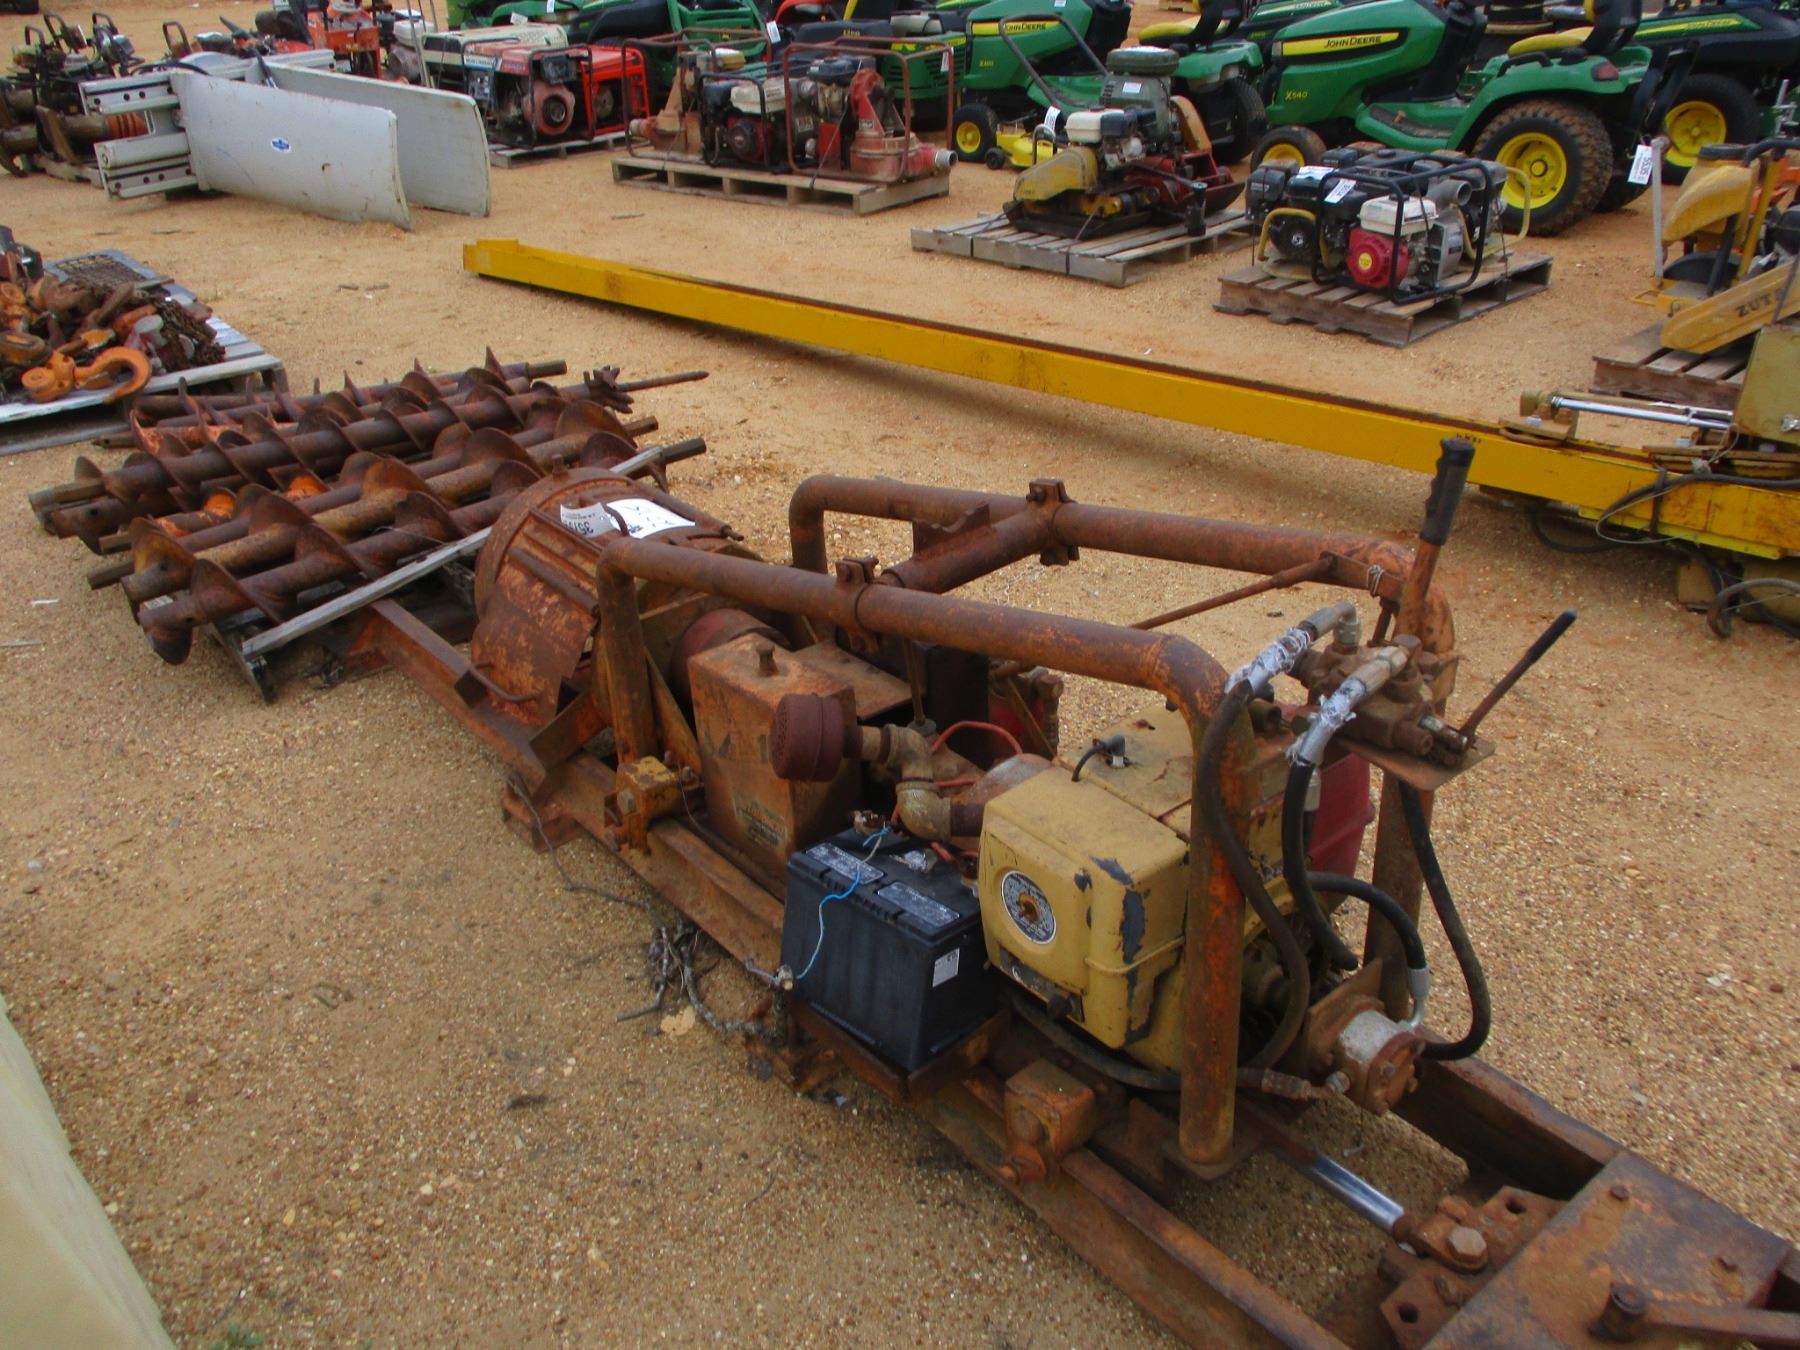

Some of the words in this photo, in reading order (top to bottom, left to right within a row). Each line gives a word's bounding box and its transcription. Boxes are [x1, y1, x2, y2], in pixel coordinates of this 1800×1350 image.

[1021, 22, 1047, 31] DEERE
[1323, 38, 1349, 49] JOHN
[1349, 35, 1383, 46] DEERE
